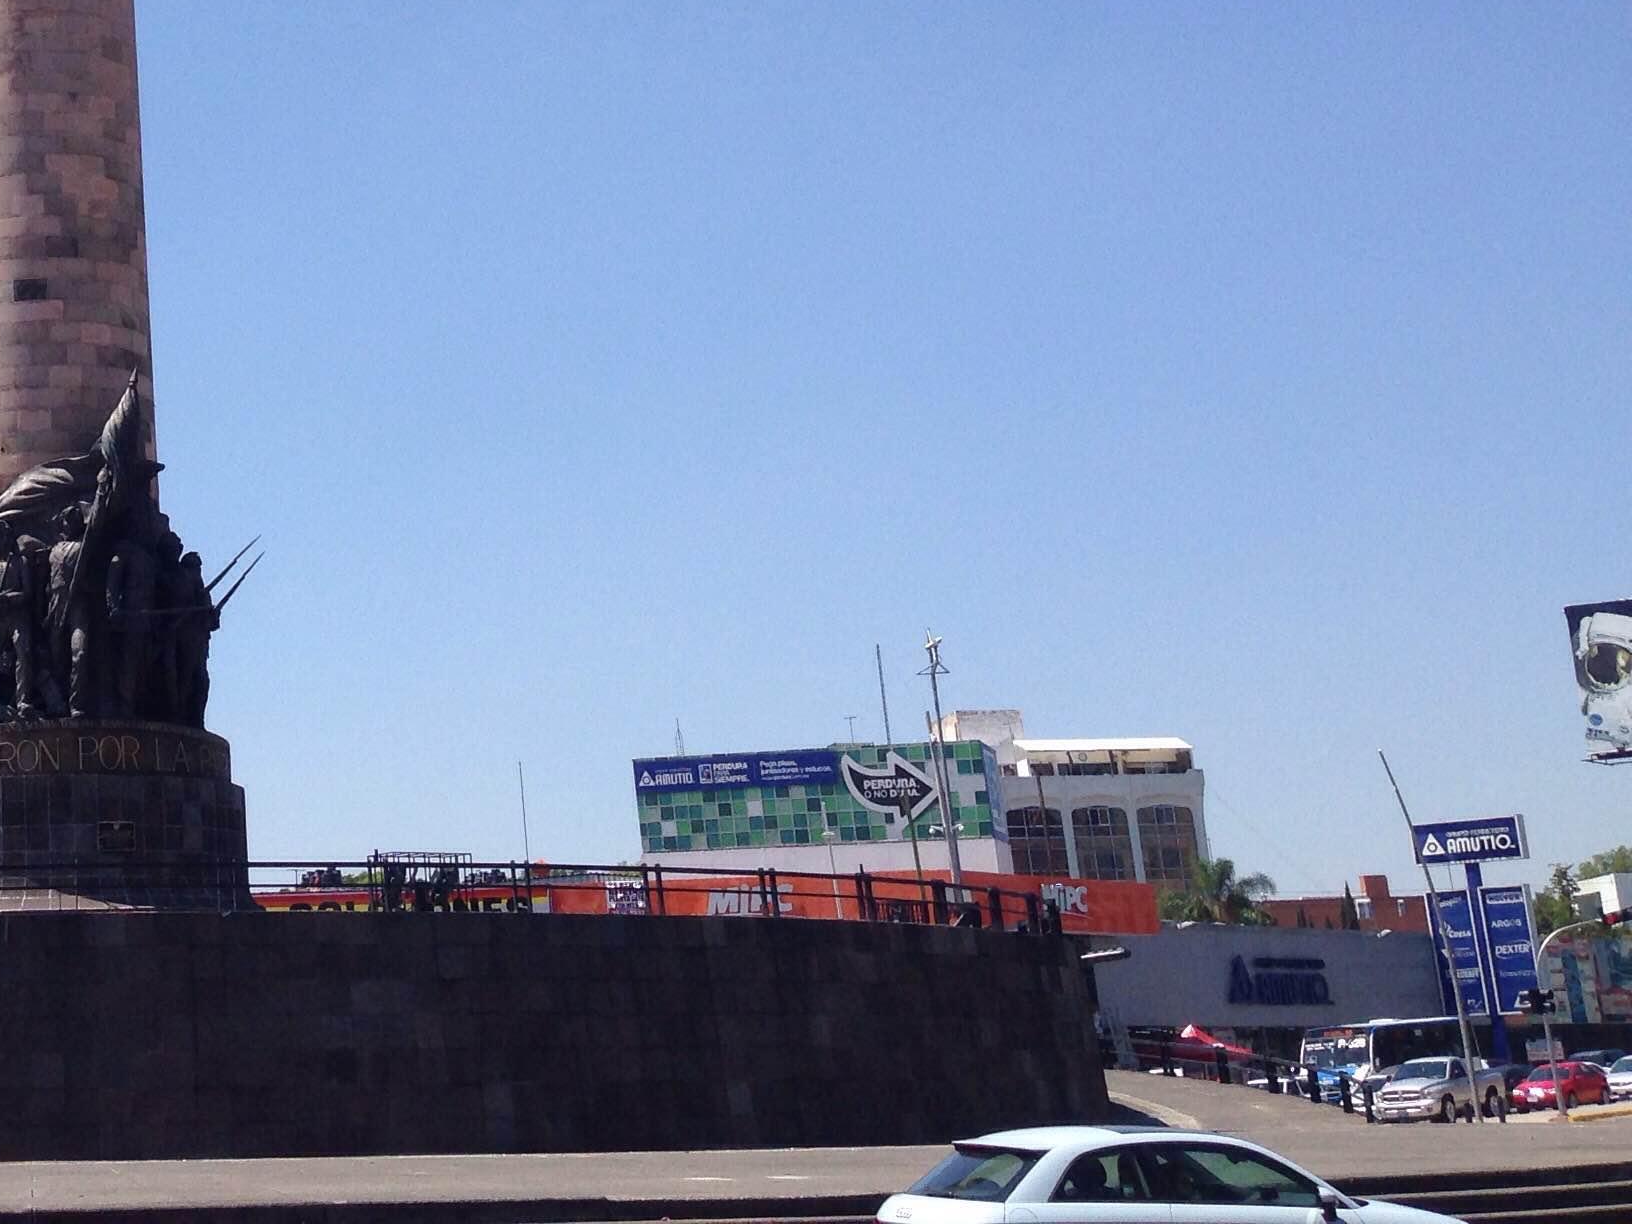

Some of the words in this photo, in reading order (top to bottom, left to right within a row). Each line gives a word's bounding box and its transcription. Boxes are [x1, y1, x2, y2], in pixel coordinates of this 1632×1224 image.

[79, 735, 141, 770] POR
[155, 738, 190, 772] LA
[1446, 834, 1511, 854] AMUTIO
